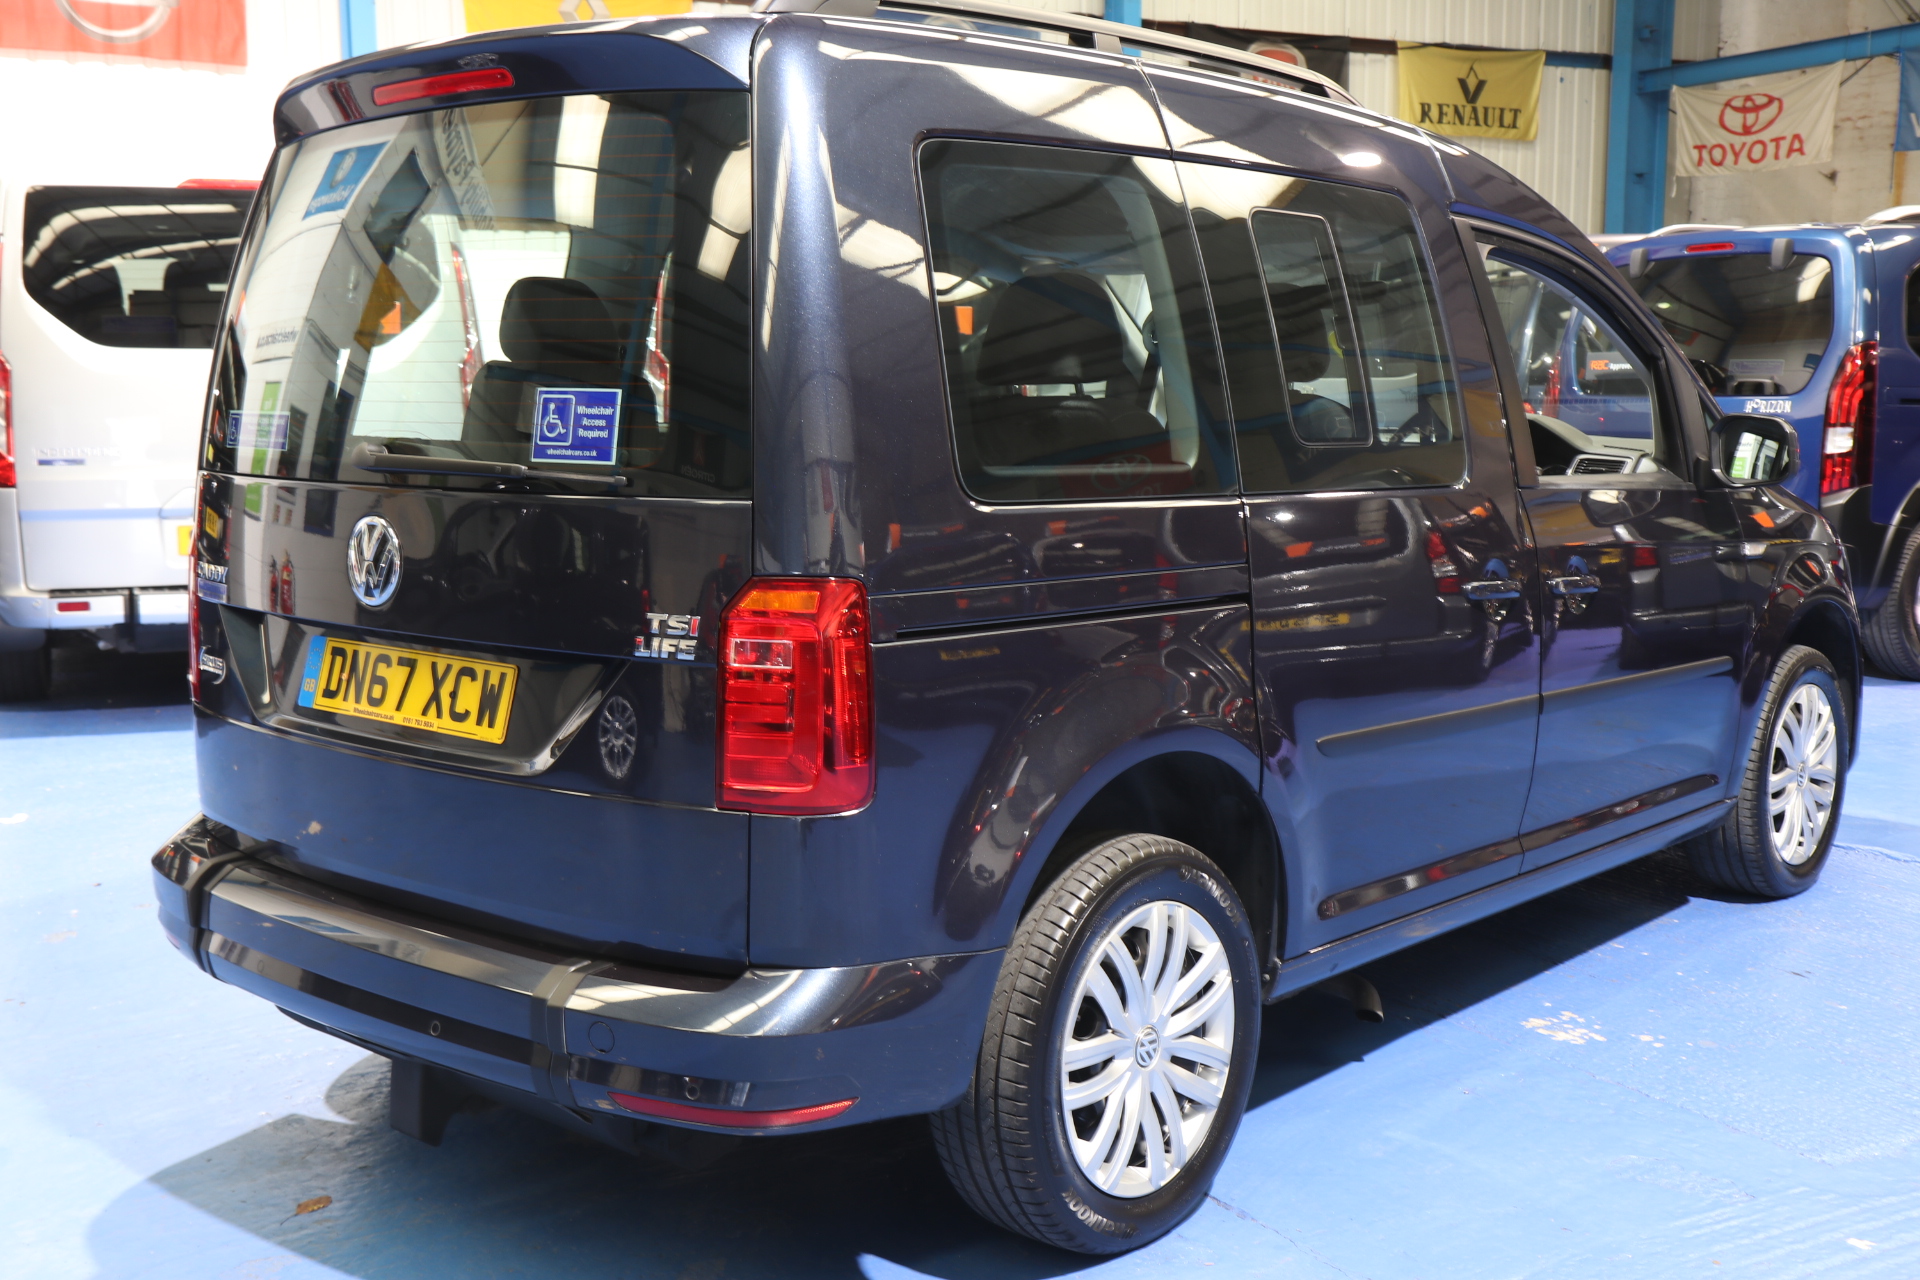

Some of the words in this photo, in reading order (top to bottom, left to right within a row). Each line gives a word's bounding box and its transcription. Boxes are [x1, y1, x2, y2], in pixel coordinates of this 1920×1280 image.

[1419, 102, 1522, 129] RENAULT
[1693, 133, 1806, 167] TOYOTA
[1590, 360, 1610, 370] RAC
[577, 406, 614, 416] Wheelchair
[1743, 399, 1792, 413] HORIZON
[582, 417, 606, 427] Access
[577, 428, 609, 439] Required
[634, 635, 698, 660] LIFE
[303, 678, 316, 692] GB
[321, 646, 418, 712] DN67
[421, 660, 507, 729] XCW
